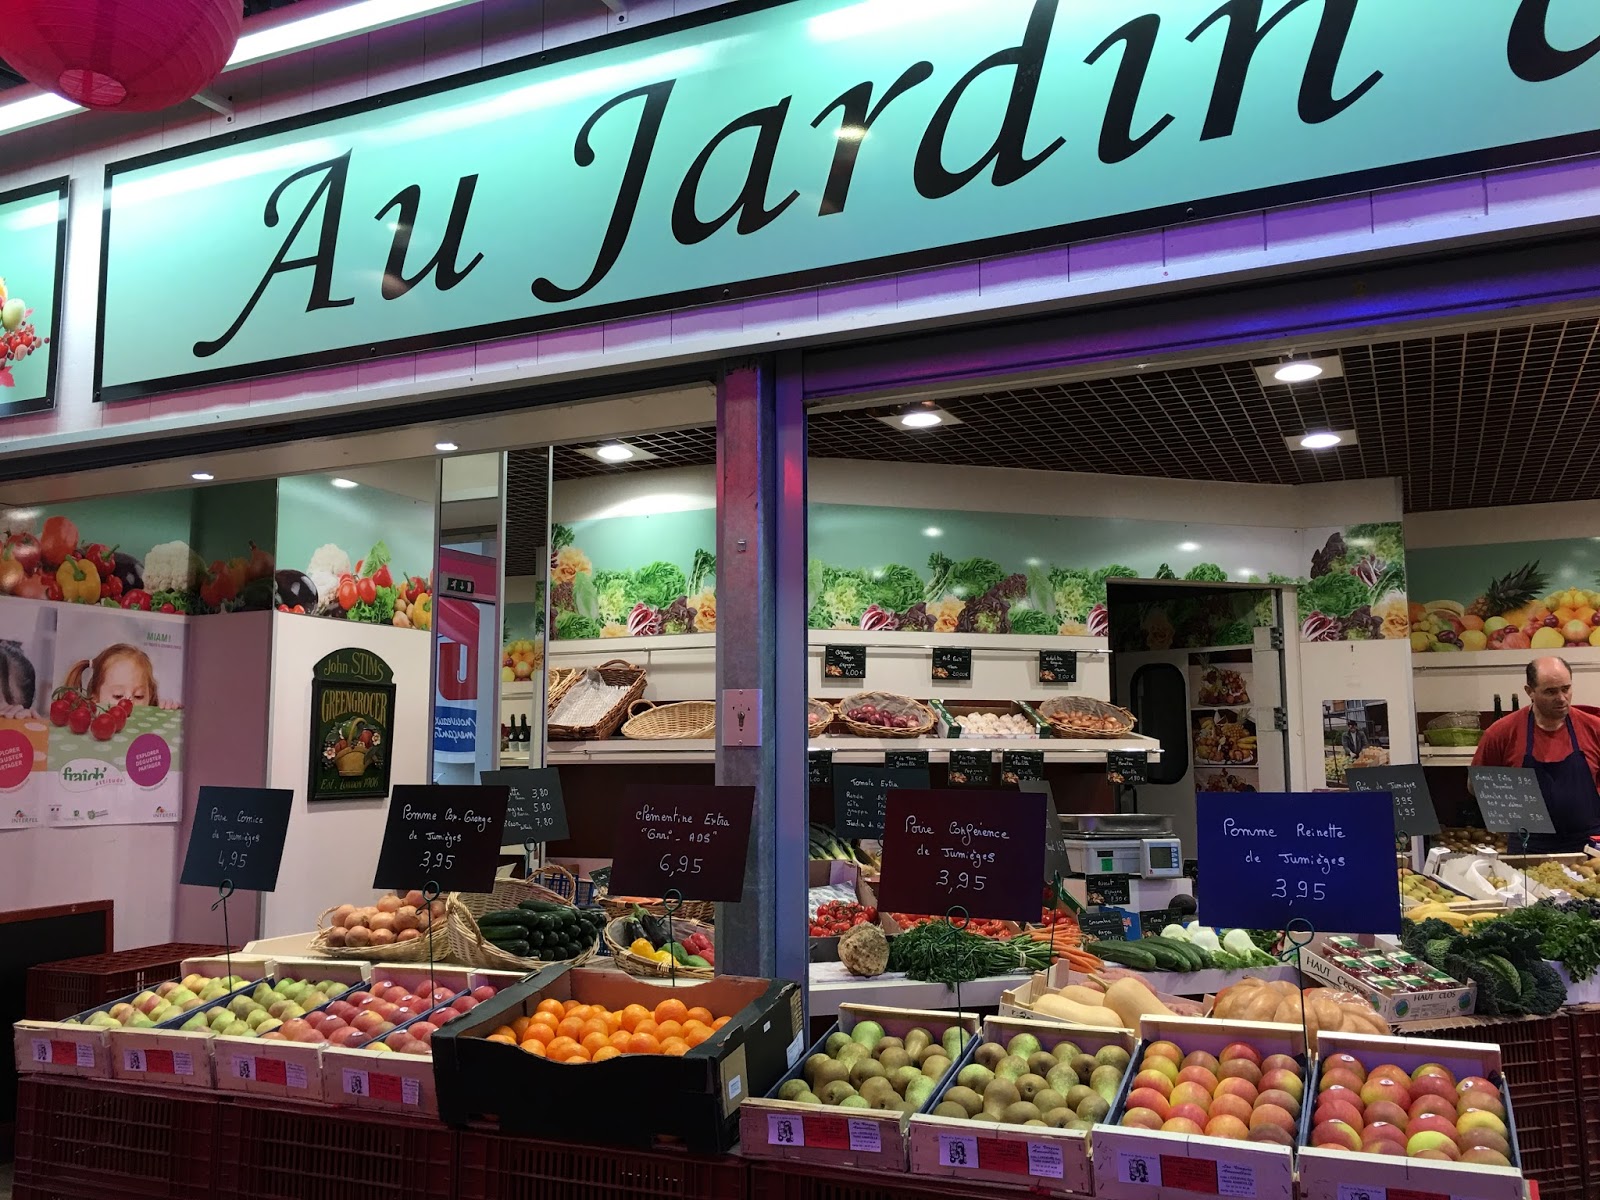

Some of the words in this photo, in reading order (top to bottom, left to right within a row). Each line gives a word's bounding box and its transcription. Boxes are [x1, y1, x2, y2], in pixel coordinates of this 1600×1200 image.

[193, 149, 484, 357] Au
[531, 0, 1383, 302] Jardin
[324, 655, 348, 676] John
[321, 690, 388, 728] GREENGROCER
[135, 749, 160, 760] EXPLORER
[850, 777, 874, 787] Tomate
[880, 779, 899, 788] Extra
[1355, 780, 1371, 791] Poire
[531, 787, 549, 800] 3,80
[1395, 796, 1413, 807] 3,95
[210, 807, 227, 822] Poire
[237, 810, 264, 824] Comice
[402, 804, 437, 820] Pomme
[533, 802, 551, 814] 5,80
[535, 817, 554, 828] 7,80
[703, 812, 730, 826] Extra
[905, 815, 935, 835] Poire
[1223, 818, 1278, 838] Pomme
[1296, 823, 1346, 839] Reinette
[212, 830, 219, 839] de
[226, 831, 260, 848] Jumièges
[409, 829, 418, 840] de
[425, 831, 462, 848] Jumièges
[218, 850, 248, 871] 4,95
[419, 850, 456, 874] 3,95
[659, 853, 704, 877] 6,95
[917, 844, 930, 856] de
[941, 848, 995, 868] Jumièges
[1245, 850, 1262, 863] de
[1278, 853, 1346, 875] Jumièges
[936, 869, 987, 895] 3,95
[1271, 878, 1326, 906] 3,95
[1306, 956, 1331, 978] HAUT
[1413, 993, 1433, 1002] HAUT
[1438, 991, 1456, 999] CLOS
